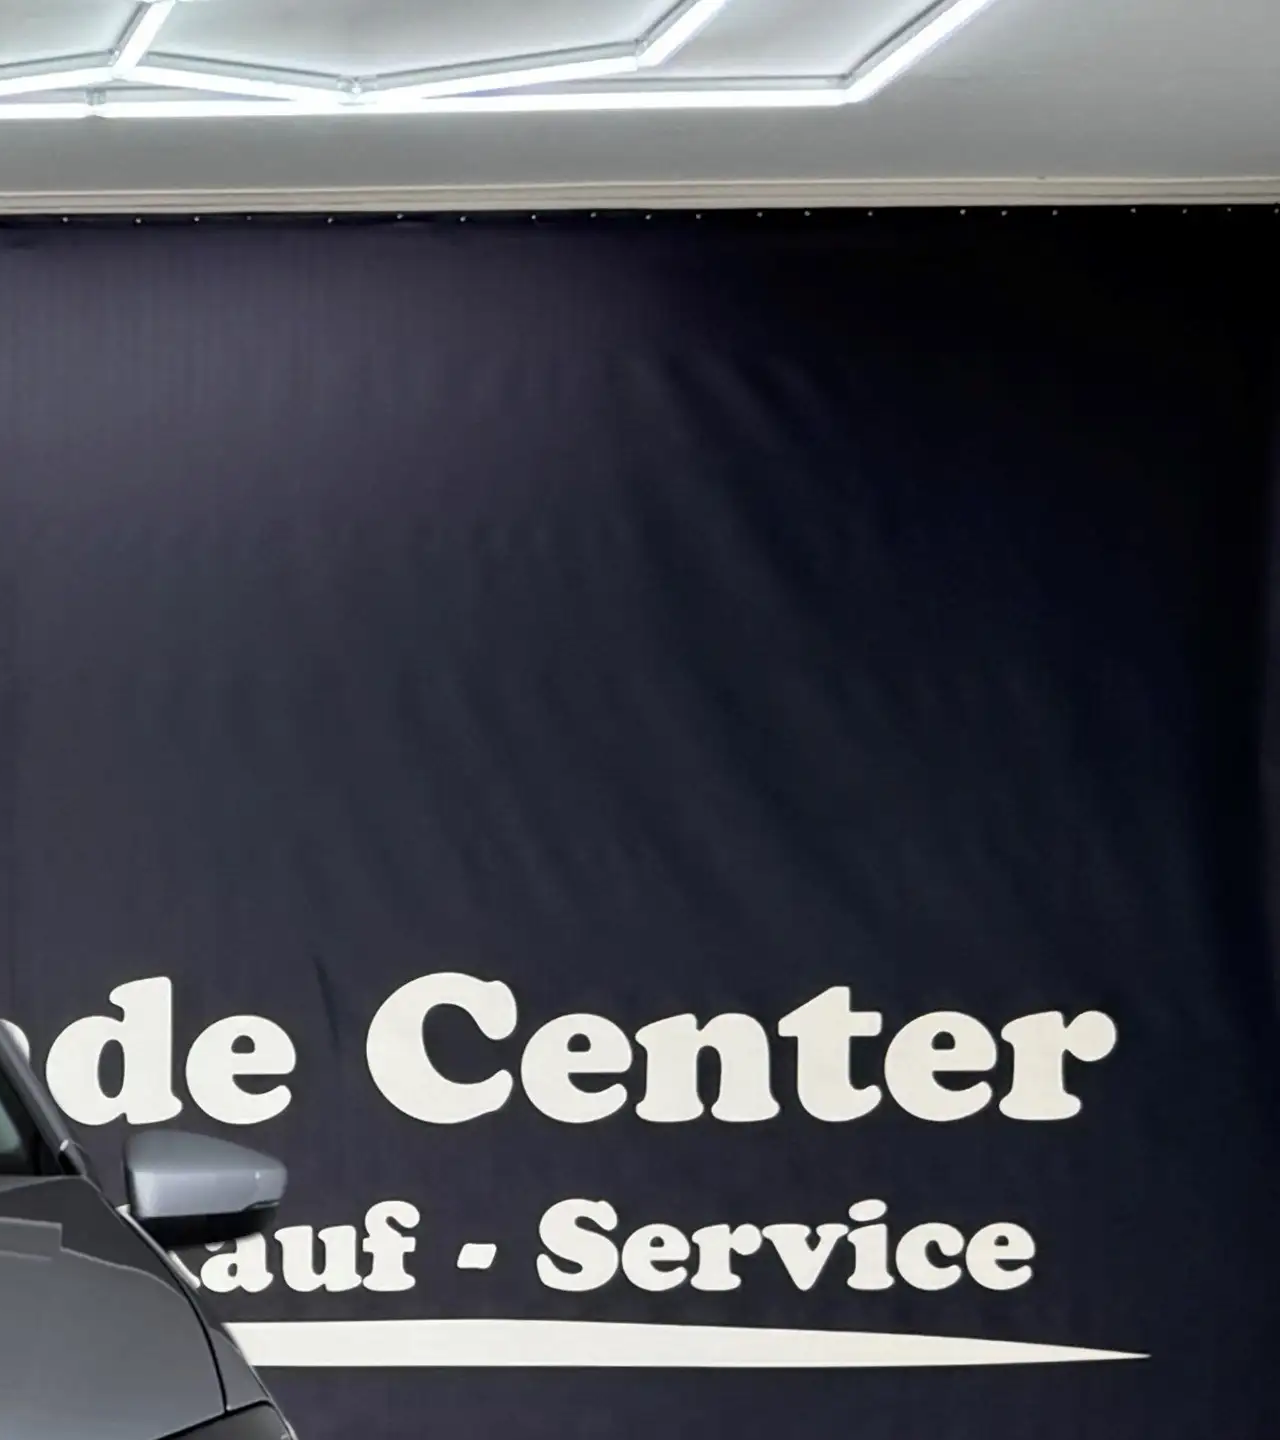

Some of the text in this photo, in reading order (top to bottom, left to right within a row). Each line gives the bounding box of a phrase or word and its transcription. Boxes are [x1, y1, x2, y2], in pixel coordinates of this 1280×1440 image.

[365, 971, 1117, 1125] Center
[168, 1200, 420, 1293] auf
[536, 1198, 1036, 1292] Service
